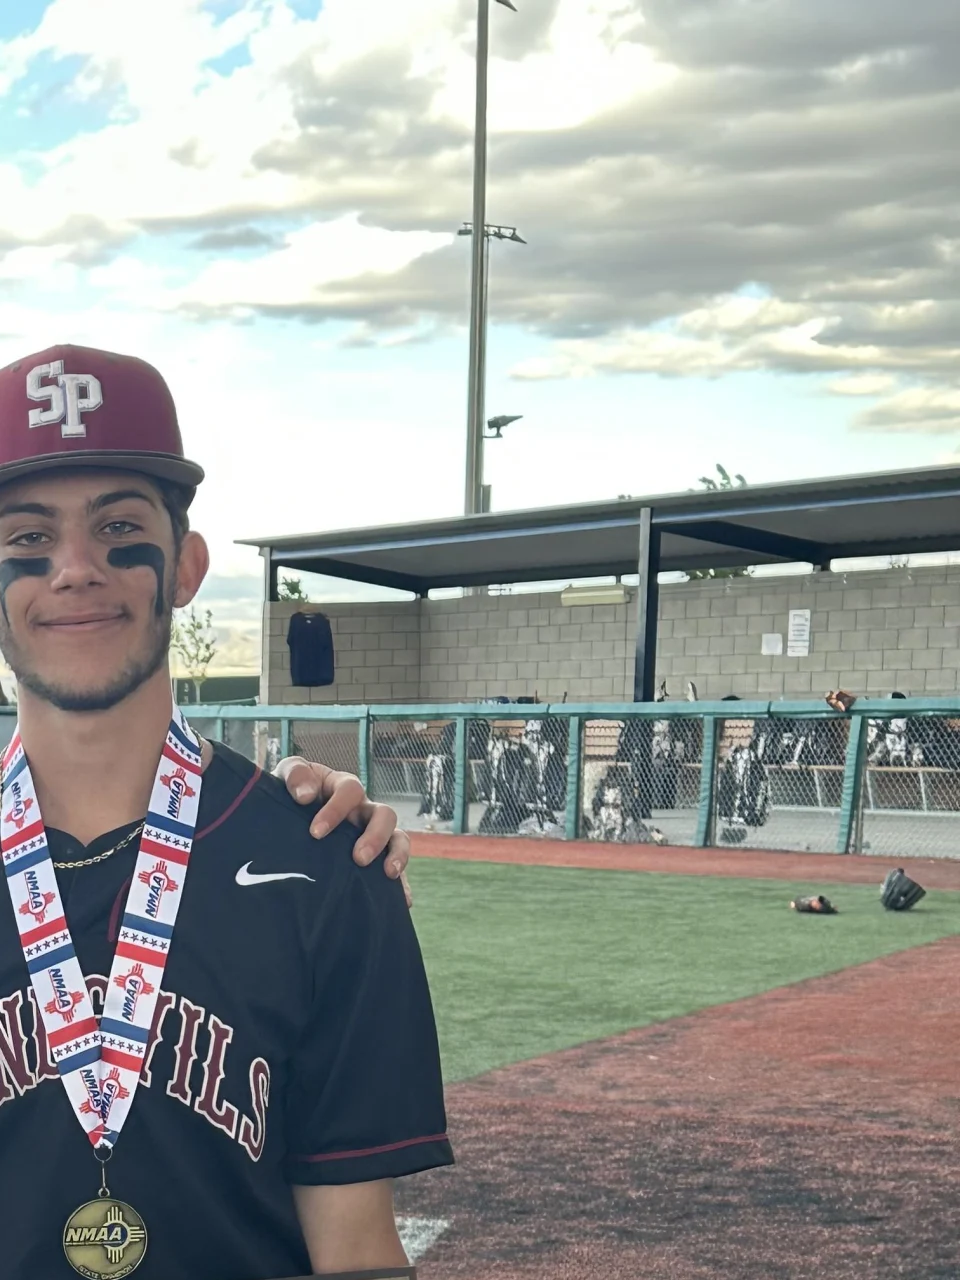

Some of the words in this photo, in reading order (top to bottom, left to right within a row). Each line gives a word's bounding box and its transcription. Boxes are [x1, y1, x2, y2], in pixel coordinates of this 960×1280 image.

[26, 359, 103, 438] SP
[166, 779, 183, 819] NMAA
[25, 870, 44, 910] NMAA
[145, 875, 164, 918] NMAA
[50, 967, 72, 1009] NMAA
[122, 978, 140, 1021] NMAA
[66, 1227, 122, 1242] NMAA
